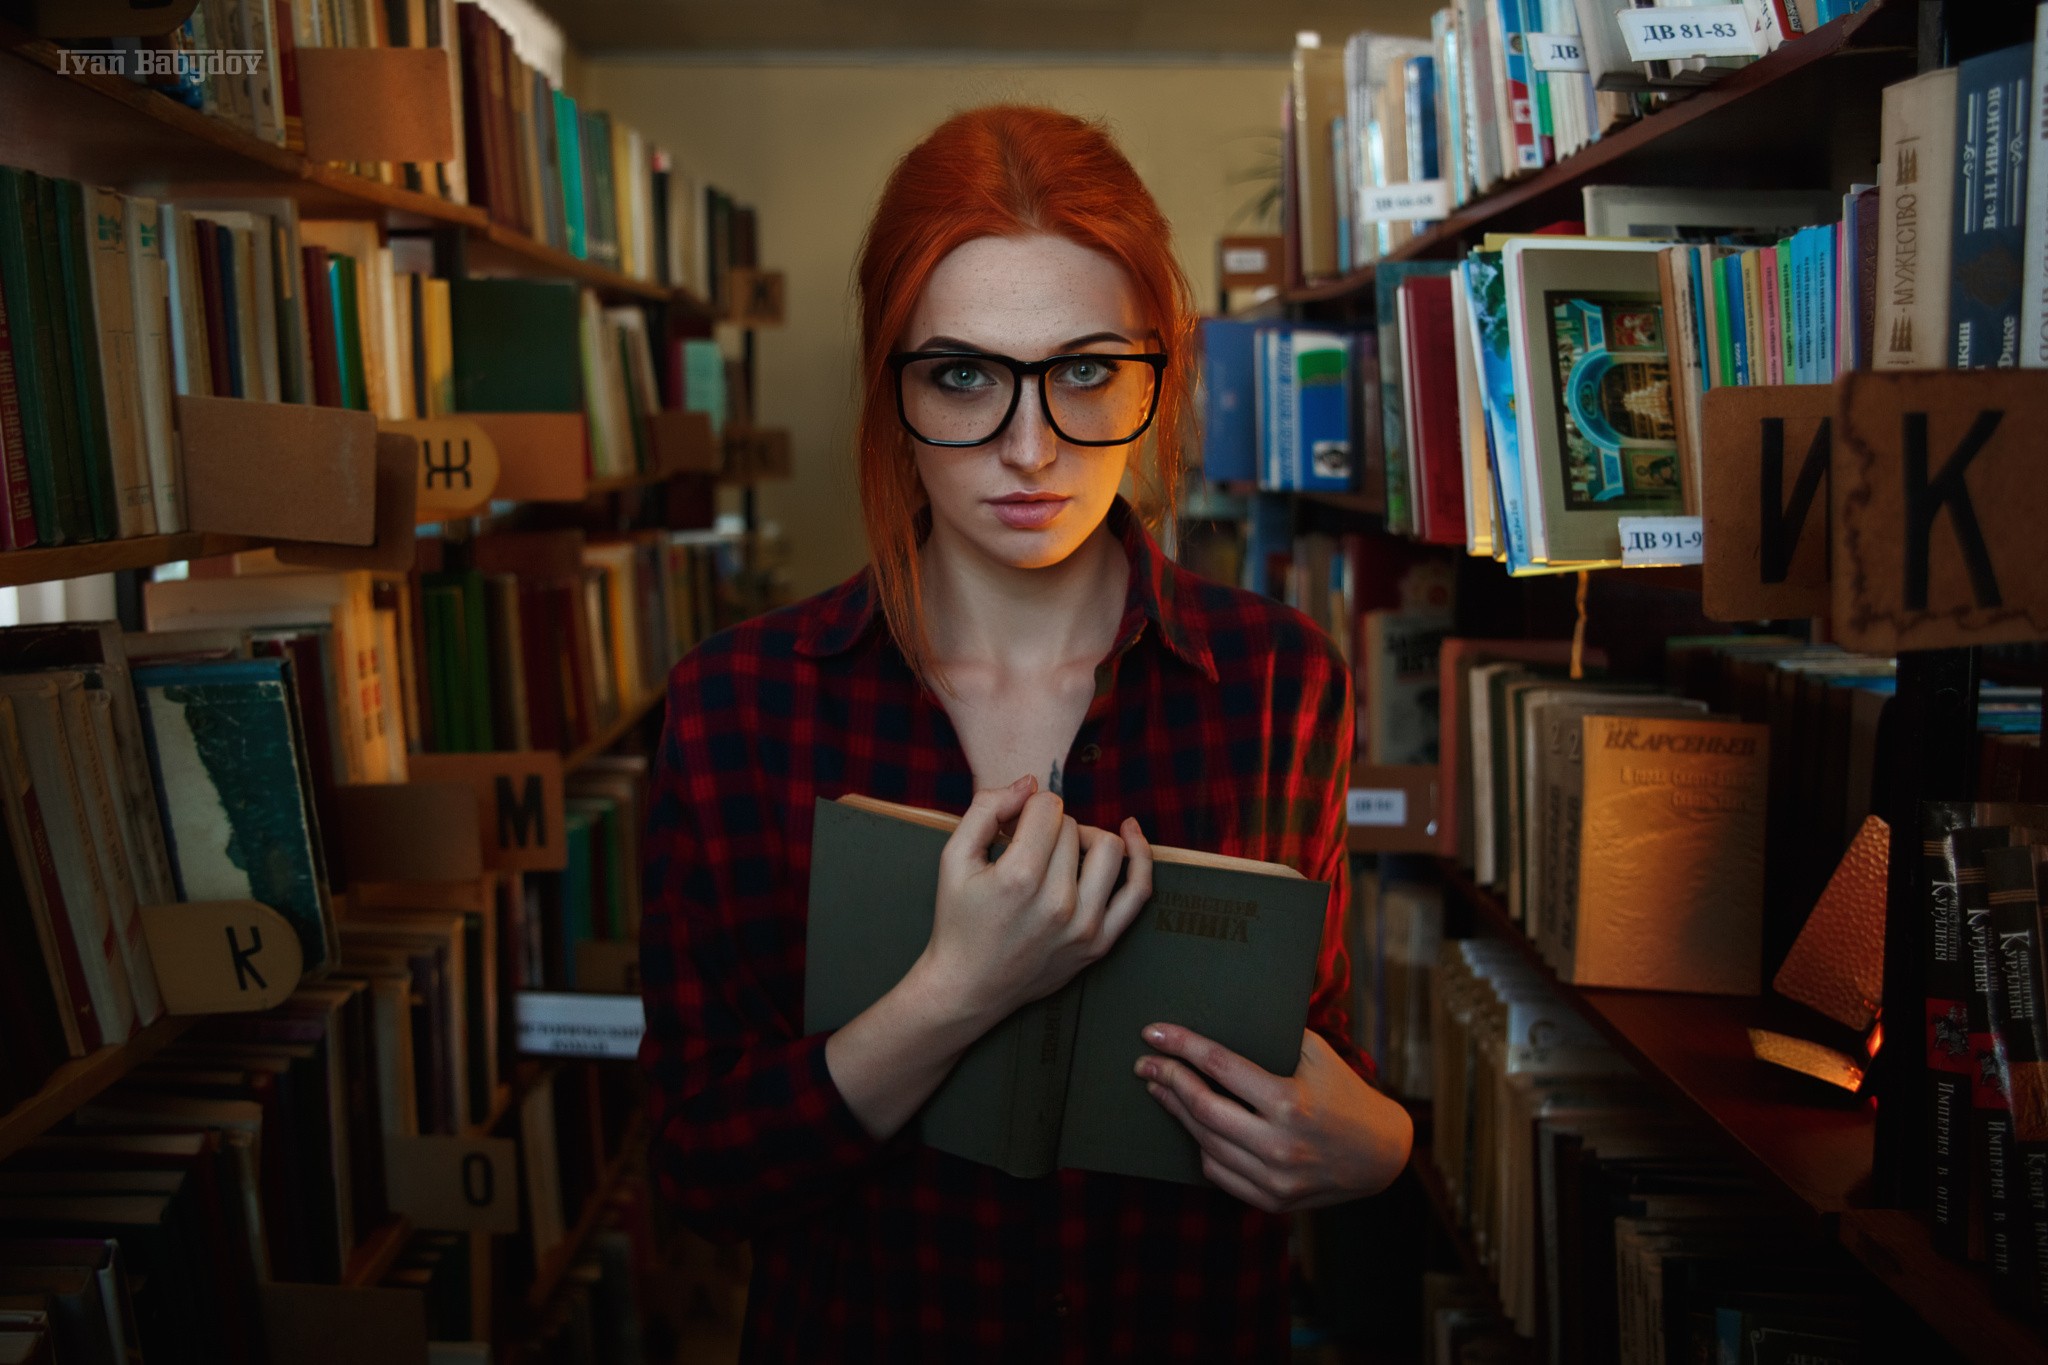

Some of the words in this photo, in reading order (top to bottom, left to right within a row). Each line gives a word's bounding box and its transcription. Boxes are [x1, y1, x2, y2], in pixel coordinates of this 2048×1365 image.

[1551, 44, 1579, 61] ДВ
[1643, 25, 1675, 42] ДВ
[1680, 23, 1737, 39] 81-83
[1893, 194, 1917, 305] МУЖЕСТВО
[423, 438, 472, 489] Ж
[1761, 417, 1831, 584] И
[1904, 409, 2005, 611] К
[1628, 532, 1657, 552] ДВ
[1662, 532, 1703, 548] 91-9
[494, 775, 546, 849] М
[1155, 909, 1249, 943] КНИГА
[226, 926, 267, 991] К
